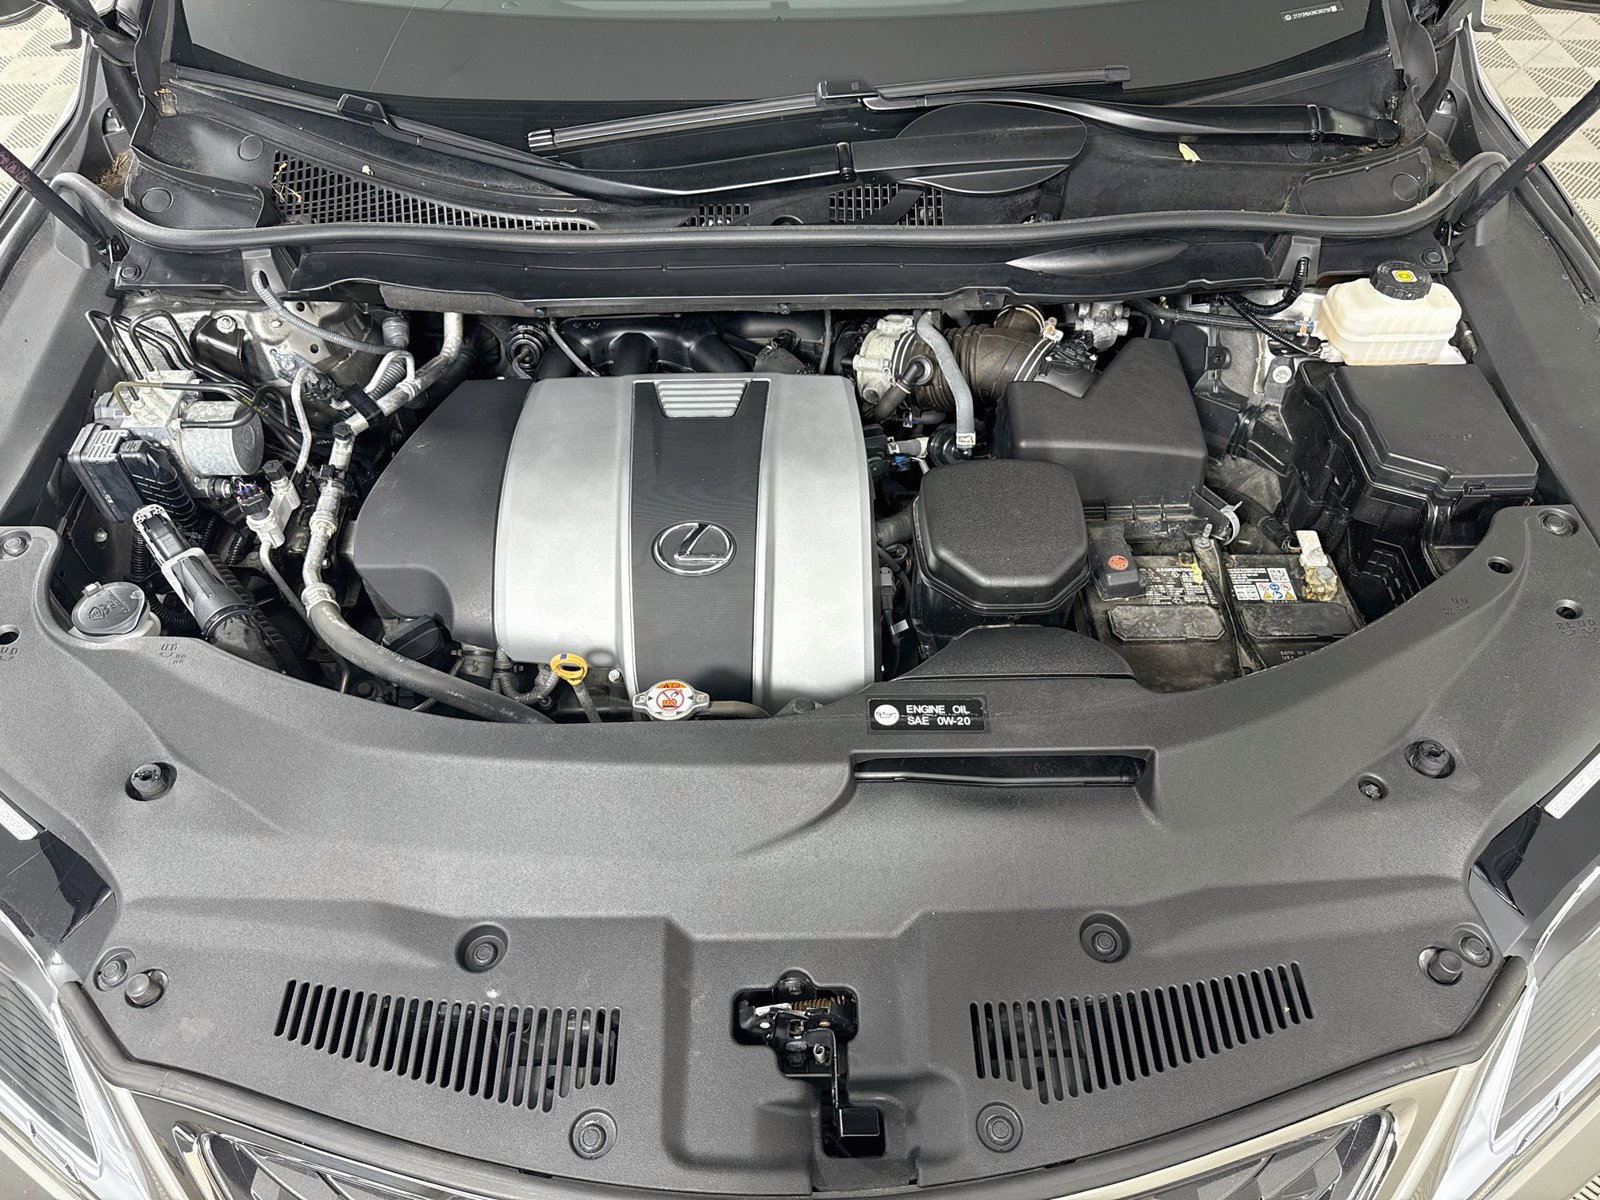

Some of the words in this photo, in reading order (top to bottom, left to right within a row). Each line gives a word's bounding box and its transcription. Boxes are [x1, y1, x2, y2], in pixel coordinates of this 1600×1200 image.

[906, 704, 945, 714] ENGINE
[952, 704, 971, 714] OIL
[908, 716, 930, 726] SAE
[937, 716, 971, 726] 0W-20
